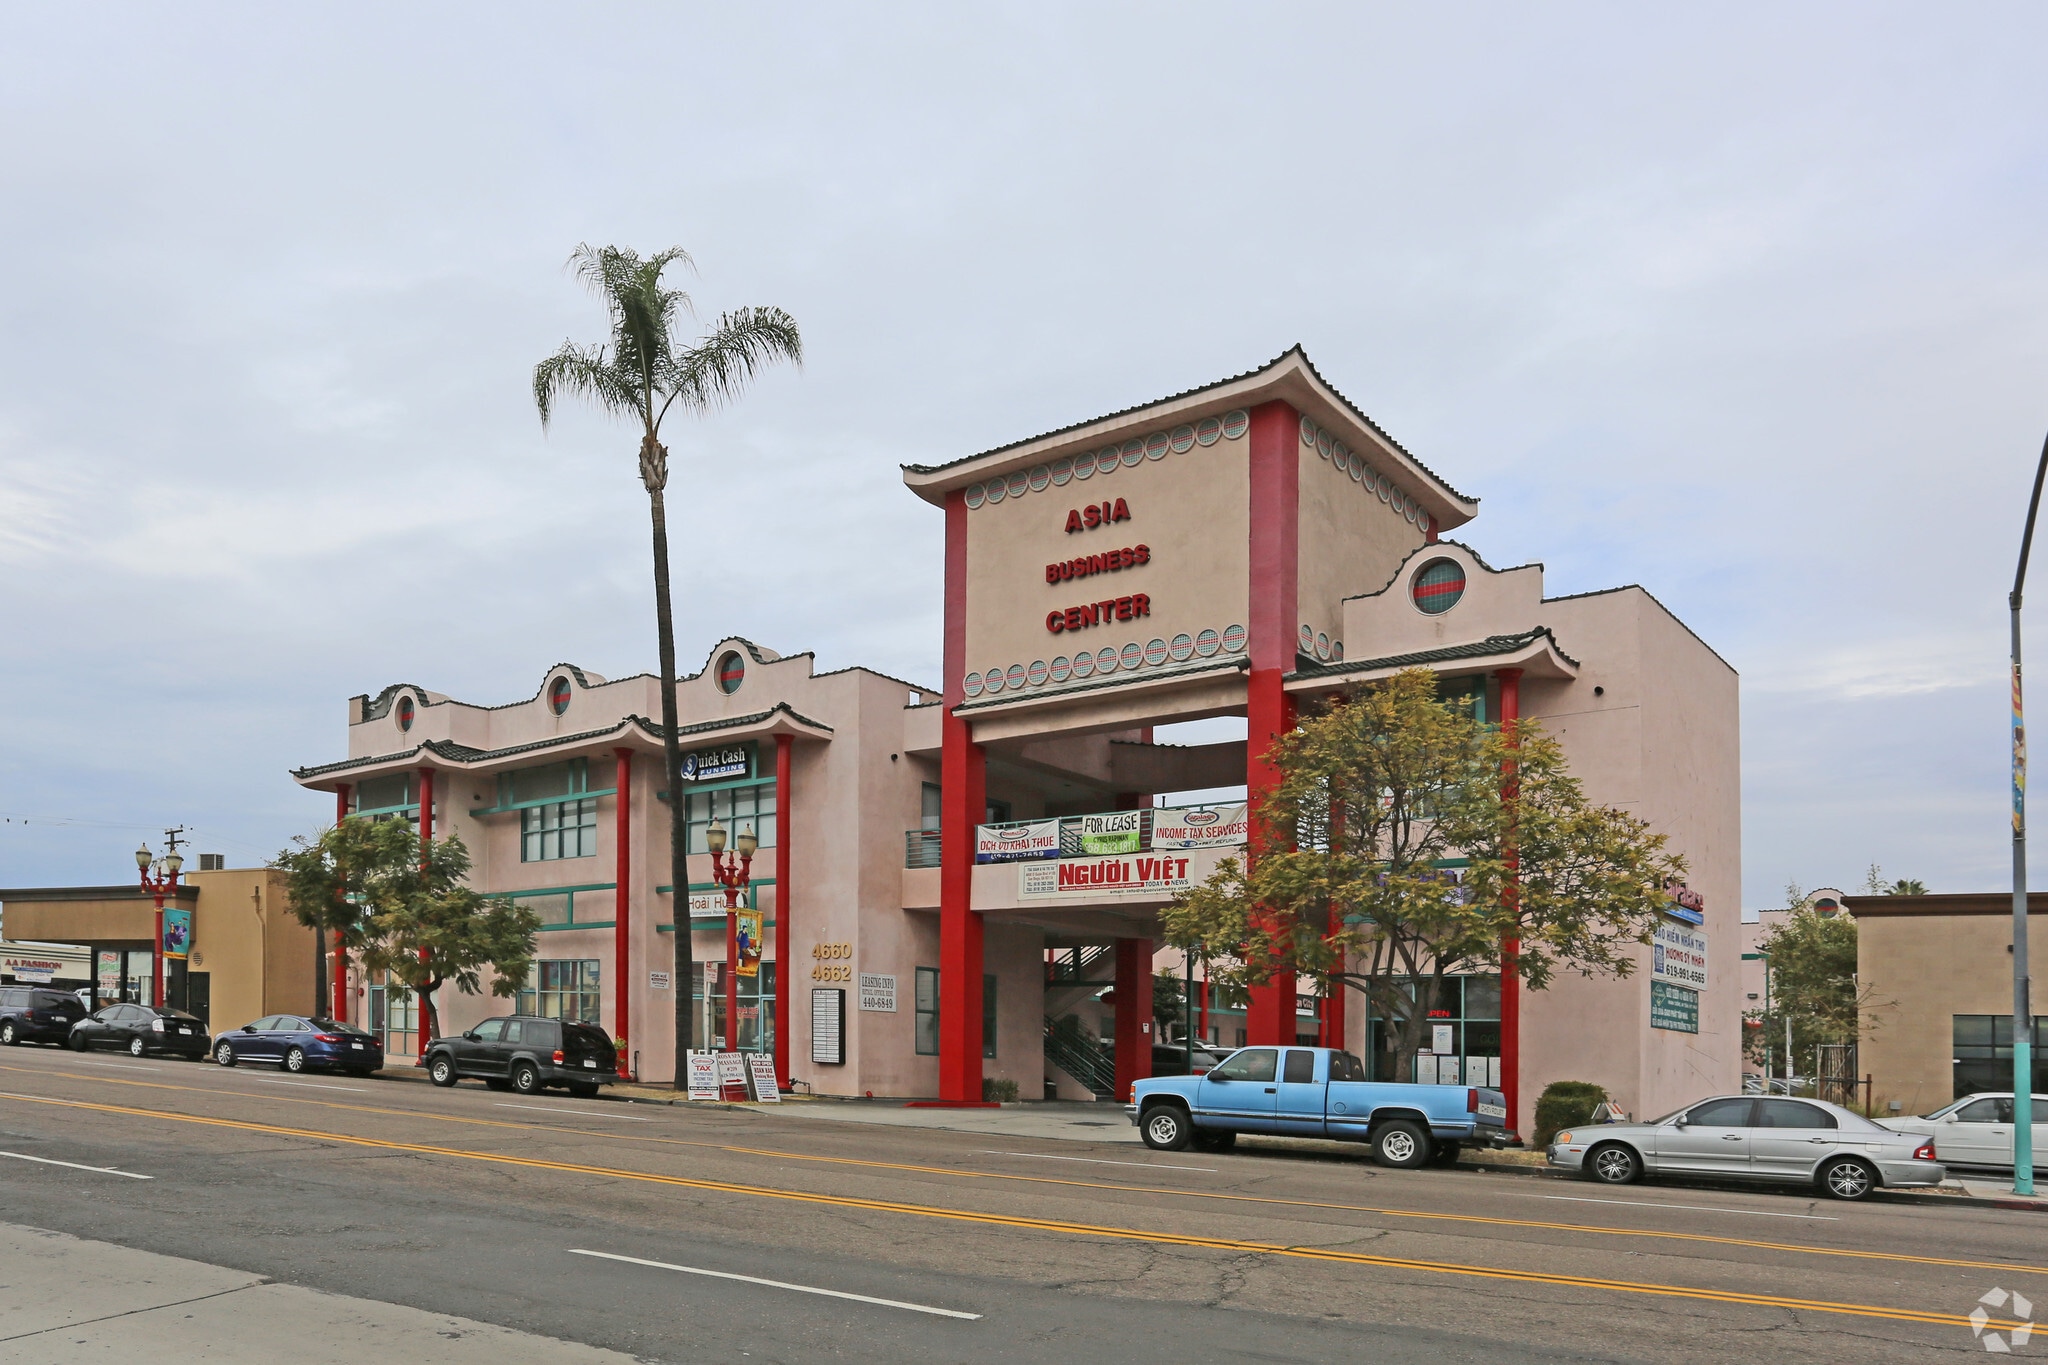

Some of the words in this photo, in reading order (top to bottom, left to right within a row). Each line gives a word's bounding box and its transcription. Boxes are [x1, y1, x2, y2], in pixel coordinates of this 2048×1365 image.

[1064, 497, 1132, 535] ASIA
[1045, 544, 1151, 585] BUSINESS
[1045, 593, 1151, 634] CENTER
[721, 747, 745, 764] Cash
[700, 763, 744, 775] FUNDING
[1084, 817, 1103, 833] FOR
[1105, 813, 1137, 832] LEASE
[1156, 827, 1187, 839] INCOME
[1189, 826, 1204, 839] TAX
[1206, 821, 1248, 838] SERVICES
[714, 896, 728, 909] Hu
[813, 943, 852, 960] 4660
[21, 960, 62, 969] FASHION
[811, 964, 851, 981] 4662
[861, 976, 882, 988] LEASING
[882, 978, 894, 989] INFO
[1666, 964, 1705, 984] 619-991-6565
[863, 997, 893, 1009] 440-6849
[1428, 1009, 1450, 1017] PEN
